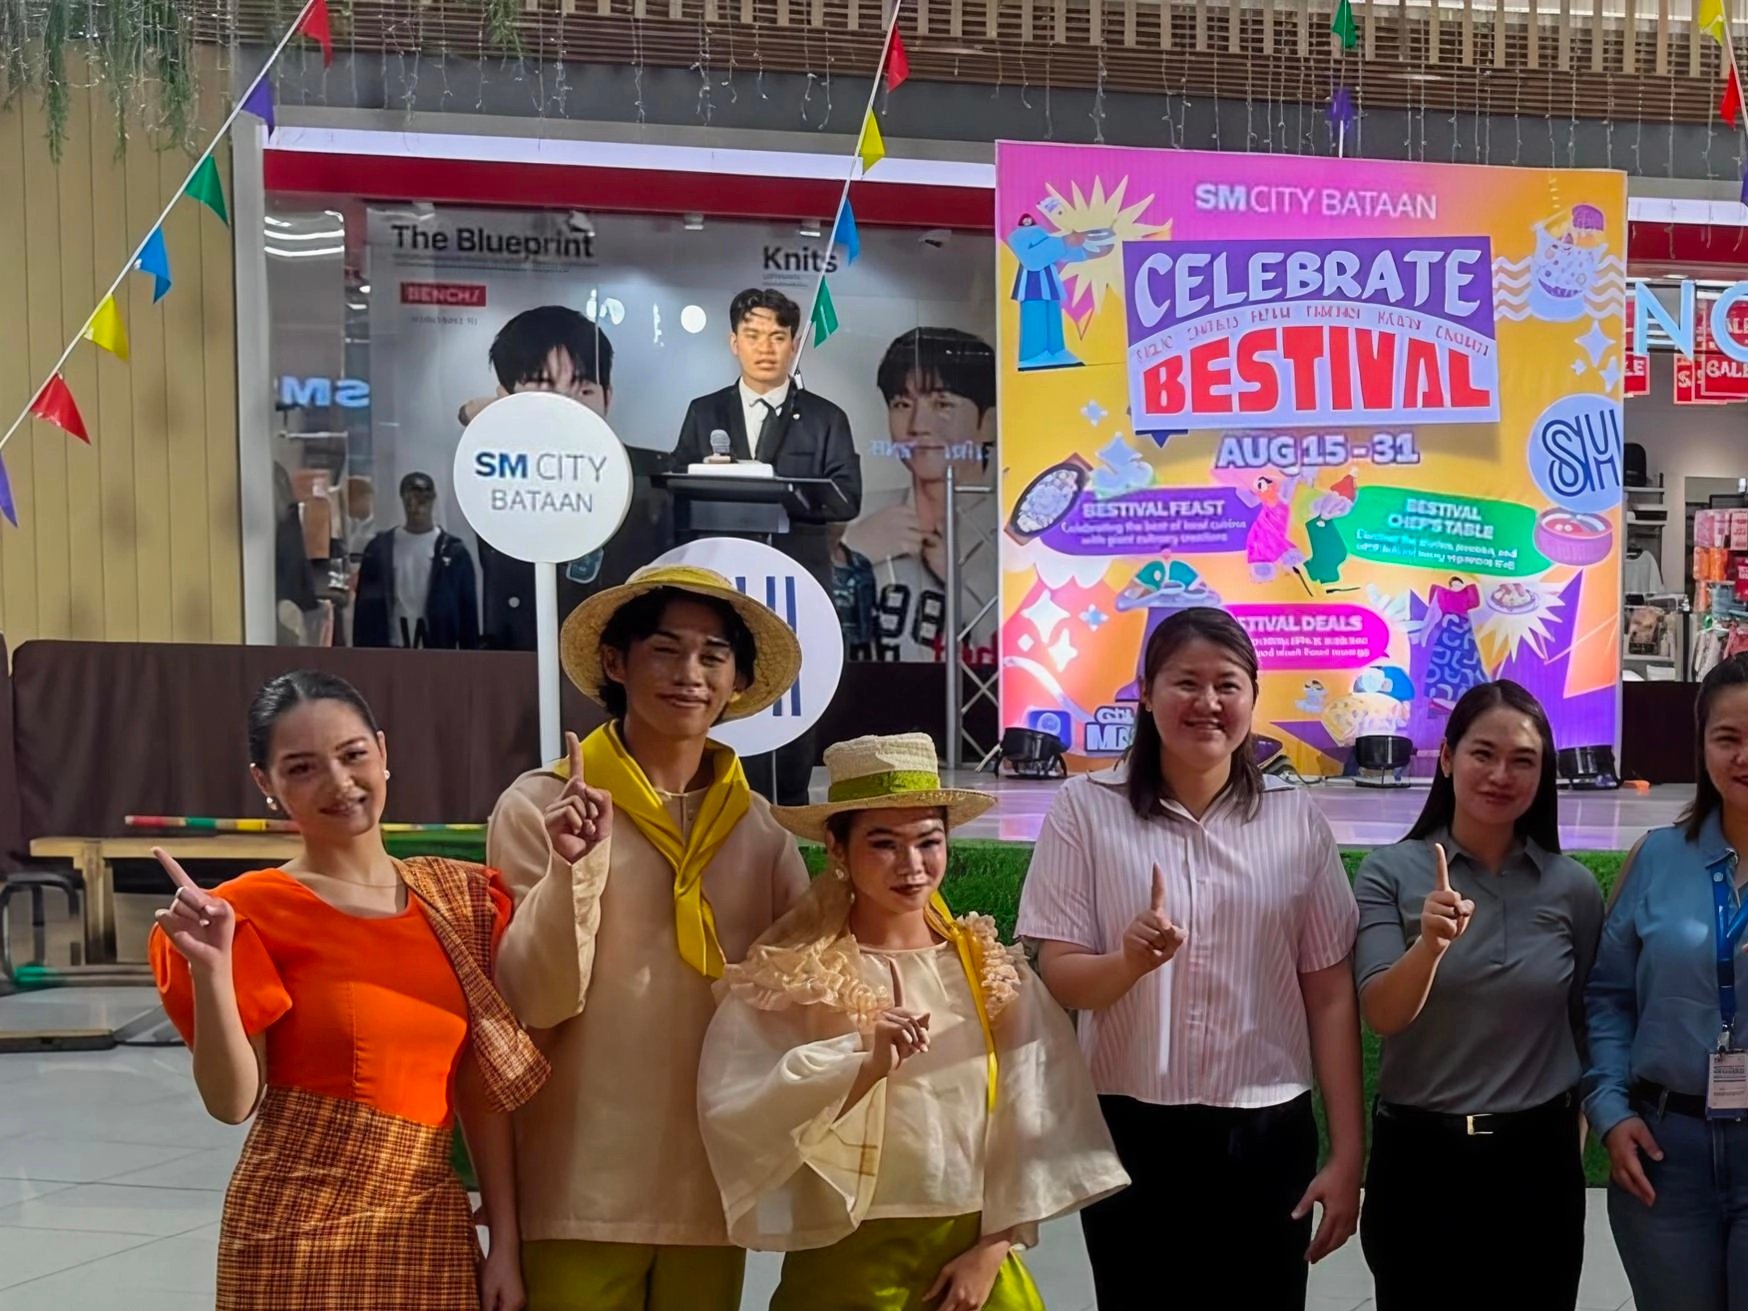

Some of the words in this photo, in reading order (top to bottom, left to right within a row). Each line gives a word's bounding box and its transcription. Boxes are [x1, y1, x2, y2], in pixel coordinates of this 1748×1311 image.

[1195, 183, 1247, 211] SM
[1250, 186, 1315, 214] CITY
[1322, 189, 1437, 220] BATAAN
[391, 225, 448, 250] The
[456, 227, 594, 260] Blueprint
[763, 246, 838, 273] Knits
[1134, 249, 1482, 328] CELEBRATE
[1143, 325, 1491, 415] BESTIVAL
[1217, 435, 1297, 468] AUG
[475, 452, 528, 479] SM
[536, 453, 607, 482] CITY
[492, 490, 592, 513] BATAAN
[1083, 501, 1167, 517] BESTIVAL
[1170, 500, 1225, 516] FEAST
[1406, 499, 1482, 521] BESTIVAL
[1444, 520, 1494, 540] TABLE
[1239, 615, 1300, 632] STIVAL
[1302, 615, 1363, 631] DEALS
